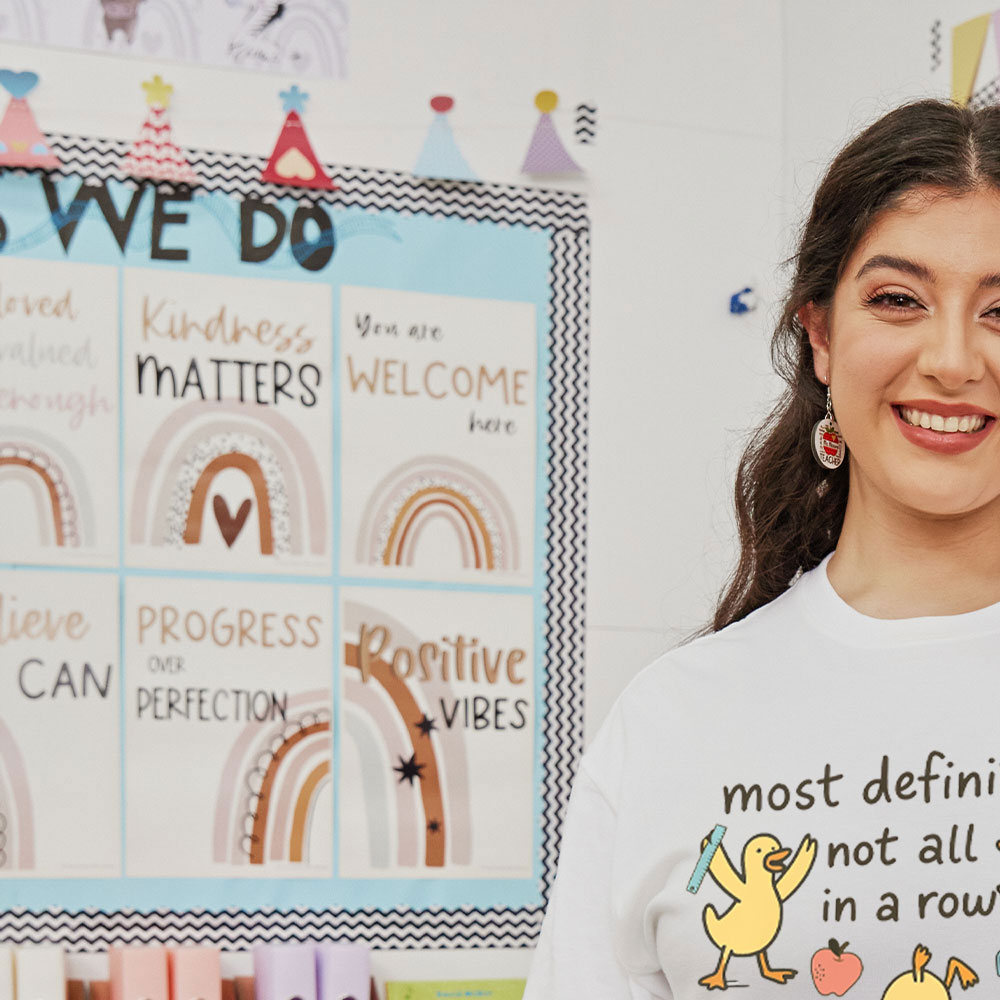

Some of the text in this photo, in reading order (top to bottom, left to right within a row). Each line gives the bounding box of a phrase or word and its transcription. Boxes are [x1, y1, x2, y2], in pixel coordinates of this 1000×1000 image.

[40, 174, 195, 261] WE
[239, 195, 336, 272] DO
[141, 294, 316, 354] Kindness
[355, 312, 443, 342] You are
[135, 354, 322, 408] MATTERS
[347, 354, 530, 406] WELCOME
[468, 410, 517, 434] here
[137, 604, 323, 648] PROGRESS
[149, 654, 187, 675] OVER
[359, 622, 527, 685] Positive
[18, 657, 113, 700] CAN
[136, 685, 288, 722] PERFECTION
[439, 695, 529, 731] VIBES
[722, 763, 844, 814] most
[826, 823, 979, 868] not all
[821, 886, 996, 922] in a row
